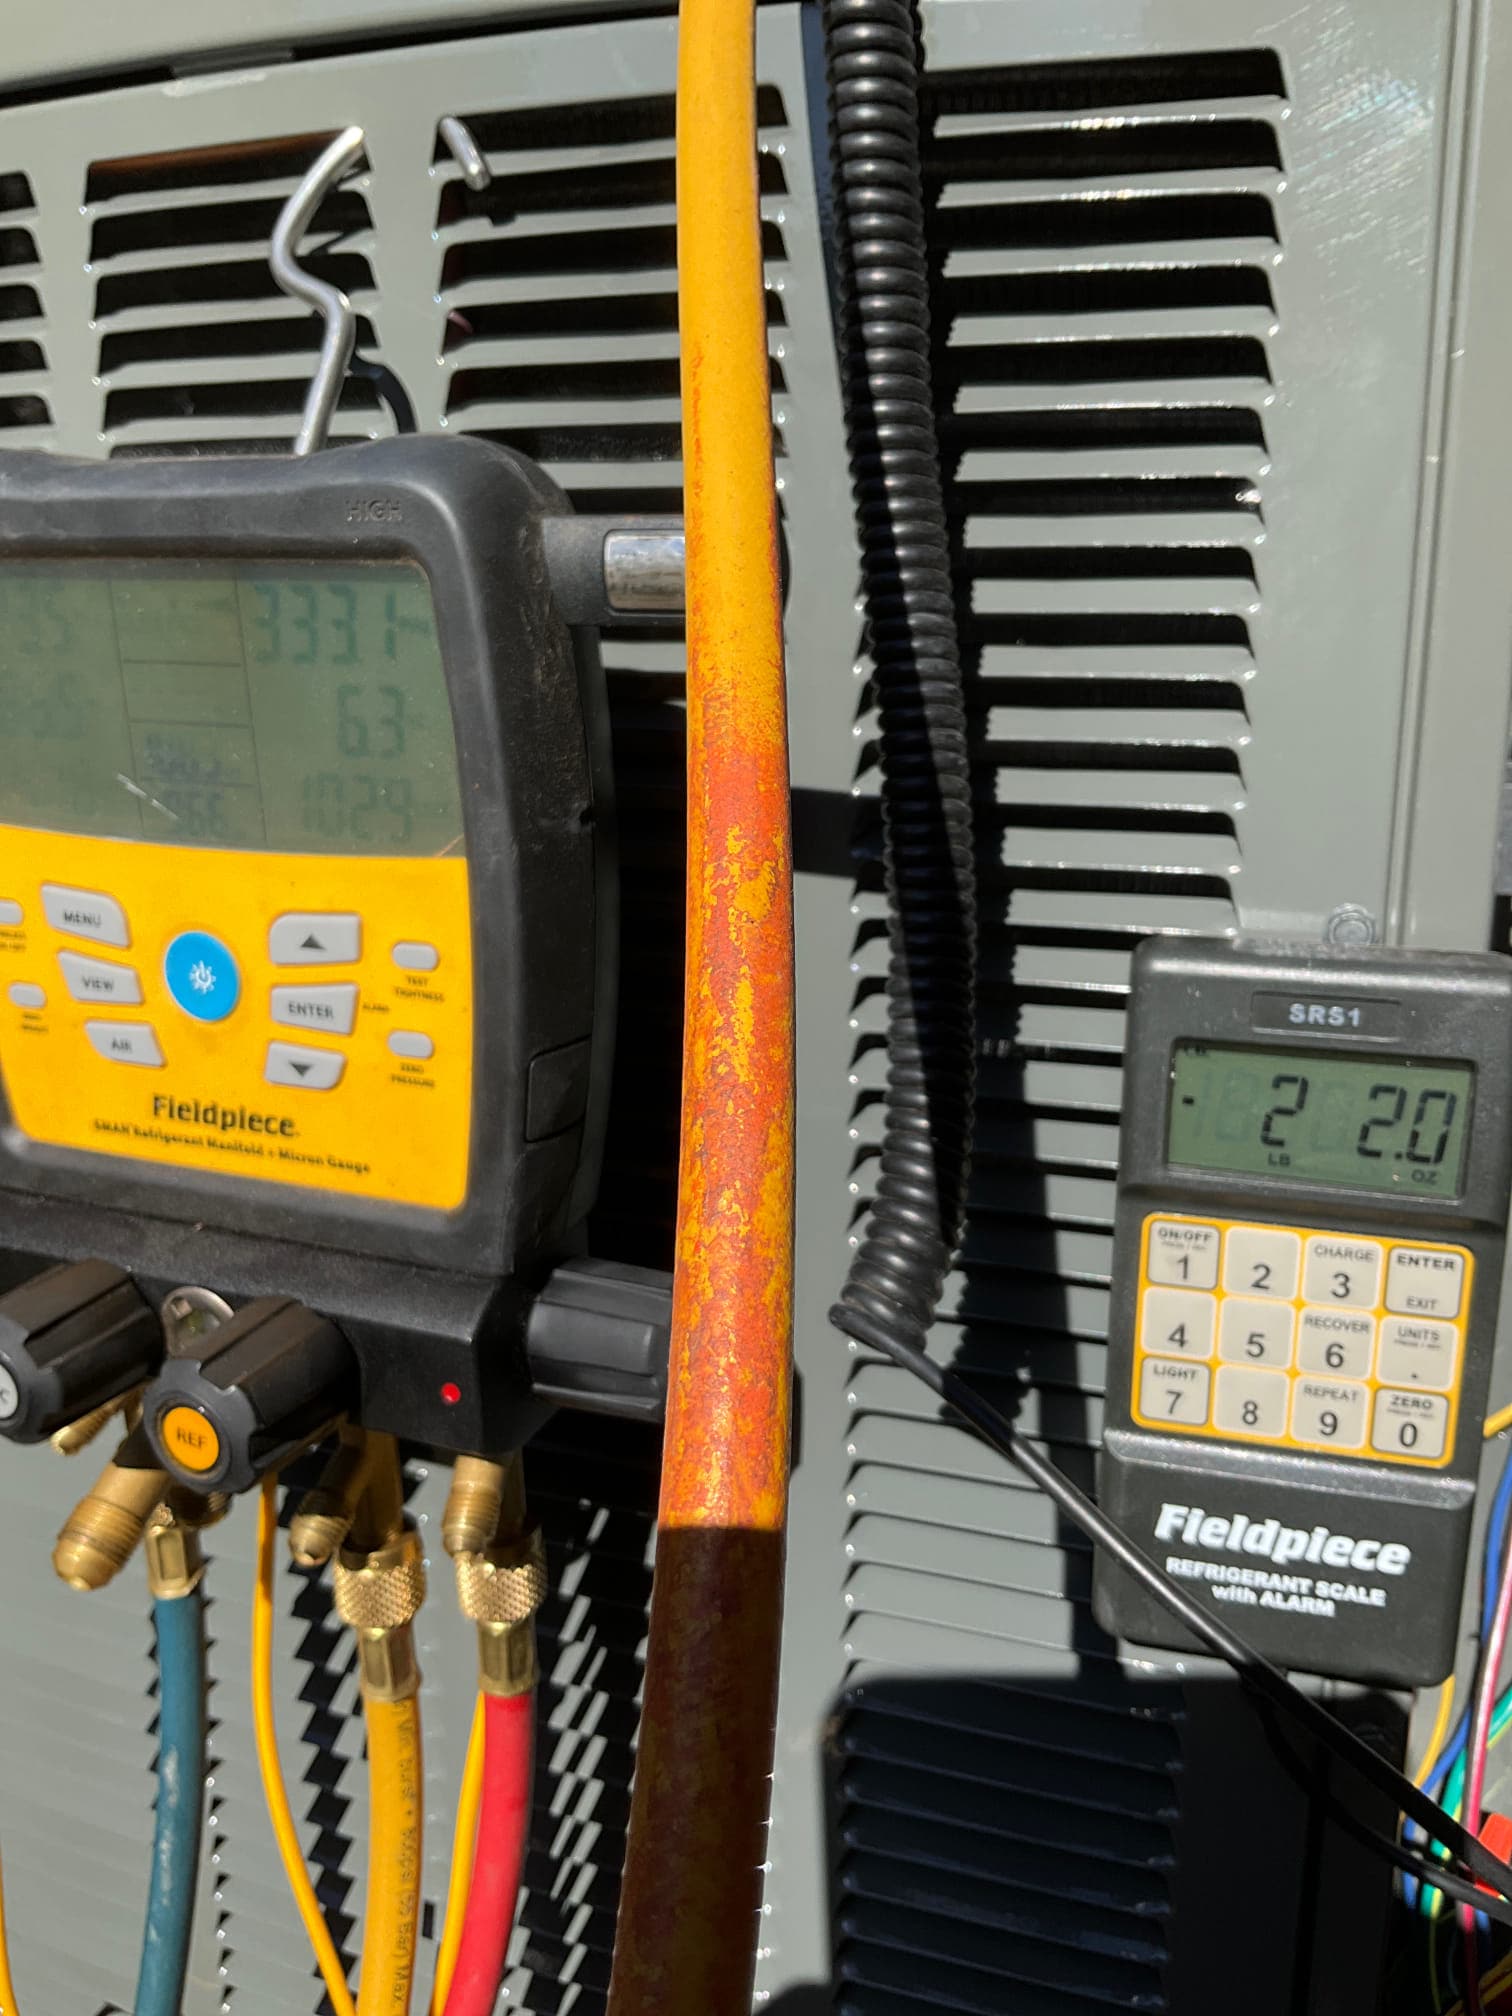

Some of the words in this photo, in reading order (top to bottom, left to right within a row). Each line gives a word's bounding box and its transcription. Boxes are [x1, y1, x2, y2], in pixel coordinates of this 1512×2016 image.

[347, 500, 402, 522] HIGH
[63, 910, 103, 928] MENU
[81, 975, 115, 992] VIEW
[287, 1001, 334, 1019] ENTER
[111, 1036, 133, 1054] AIR
[153, 1094, 295, 1138] Fieldpiece
[1356, 1084, 1458, 1165] 2.0
[207, 1138, 264, 1156] Manifold
[278, 1148, 324, 1166] Micron
[1267, 1152, 1291, 1167] LB
[1411, 1170, 1438, 1185] OZ
[1157, 1227, 1213, 1243] ON/OFF
[1314, 1244, 1375, 1264] CHARGE
[1396, 1254, 1456, 1271] ENTER
[1176, 1254, 1189, 1281] 1
[1251, 1263, 1271, 1290] 2
[1331, 1273, 1351, 1299] 3
[1405, 1296, 1439, 1312] EXIT
[1168, 1323, 1188, 1349] 4
[1304, 1316, 1370, 1334] RECOVER
[1397, 1325, 1441, 1342] UNITS
[1246, 1333, 1266, 1358] 5
[1325, 1343, 1345, 1369] 6
[1152, 1365, 1198, 1382] LIGHT
[1166, 1390, 1184, 1416] 7
[1302, 1384, 1360, 1403] REPEAT
[1390, 1394, 1433, 1411] ZERO
[1241, 1401, 1260, 1426] 8
[1319, 1411, 1339, 1437] 9
[176, 1427, 208, 1449] REF
[1399, 1422, 1418, 1448] 0
[1154, 1503, 1412, 1576] Fieldpiece
[1164, 1556, 1314, 1595] REFRIGERANT
[1314, 1580, 1387, 1607] SCALE
[1211, 1584, 1258, 1605] with
[1259, 1590, 1336, 1618] ALARM
